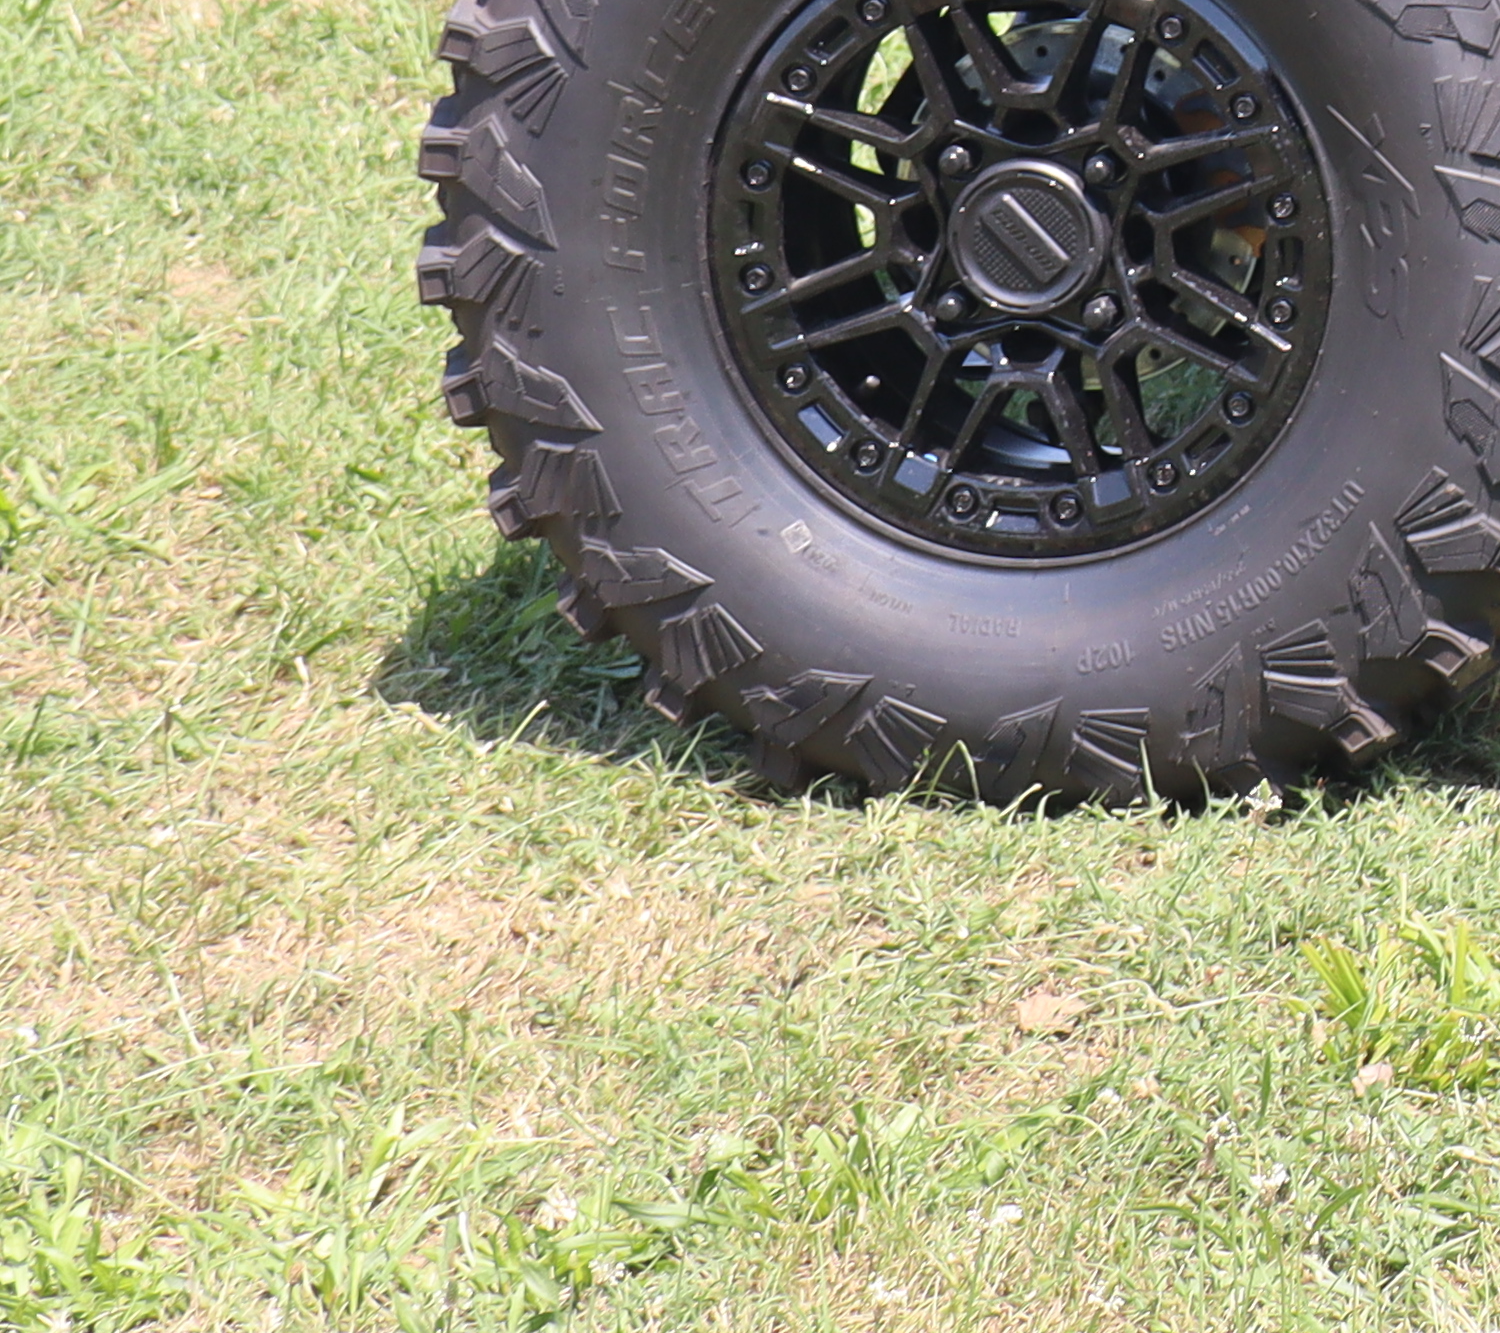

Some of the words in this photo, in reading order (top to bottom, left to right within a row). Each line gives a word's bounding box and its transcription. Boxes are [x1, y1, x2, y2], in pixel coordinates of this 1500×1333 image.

[608, 304, 728, 526] TRAC
[947, 612, 1018, 639] RADIAL
[1076, 642, 1135, 675] 102P
